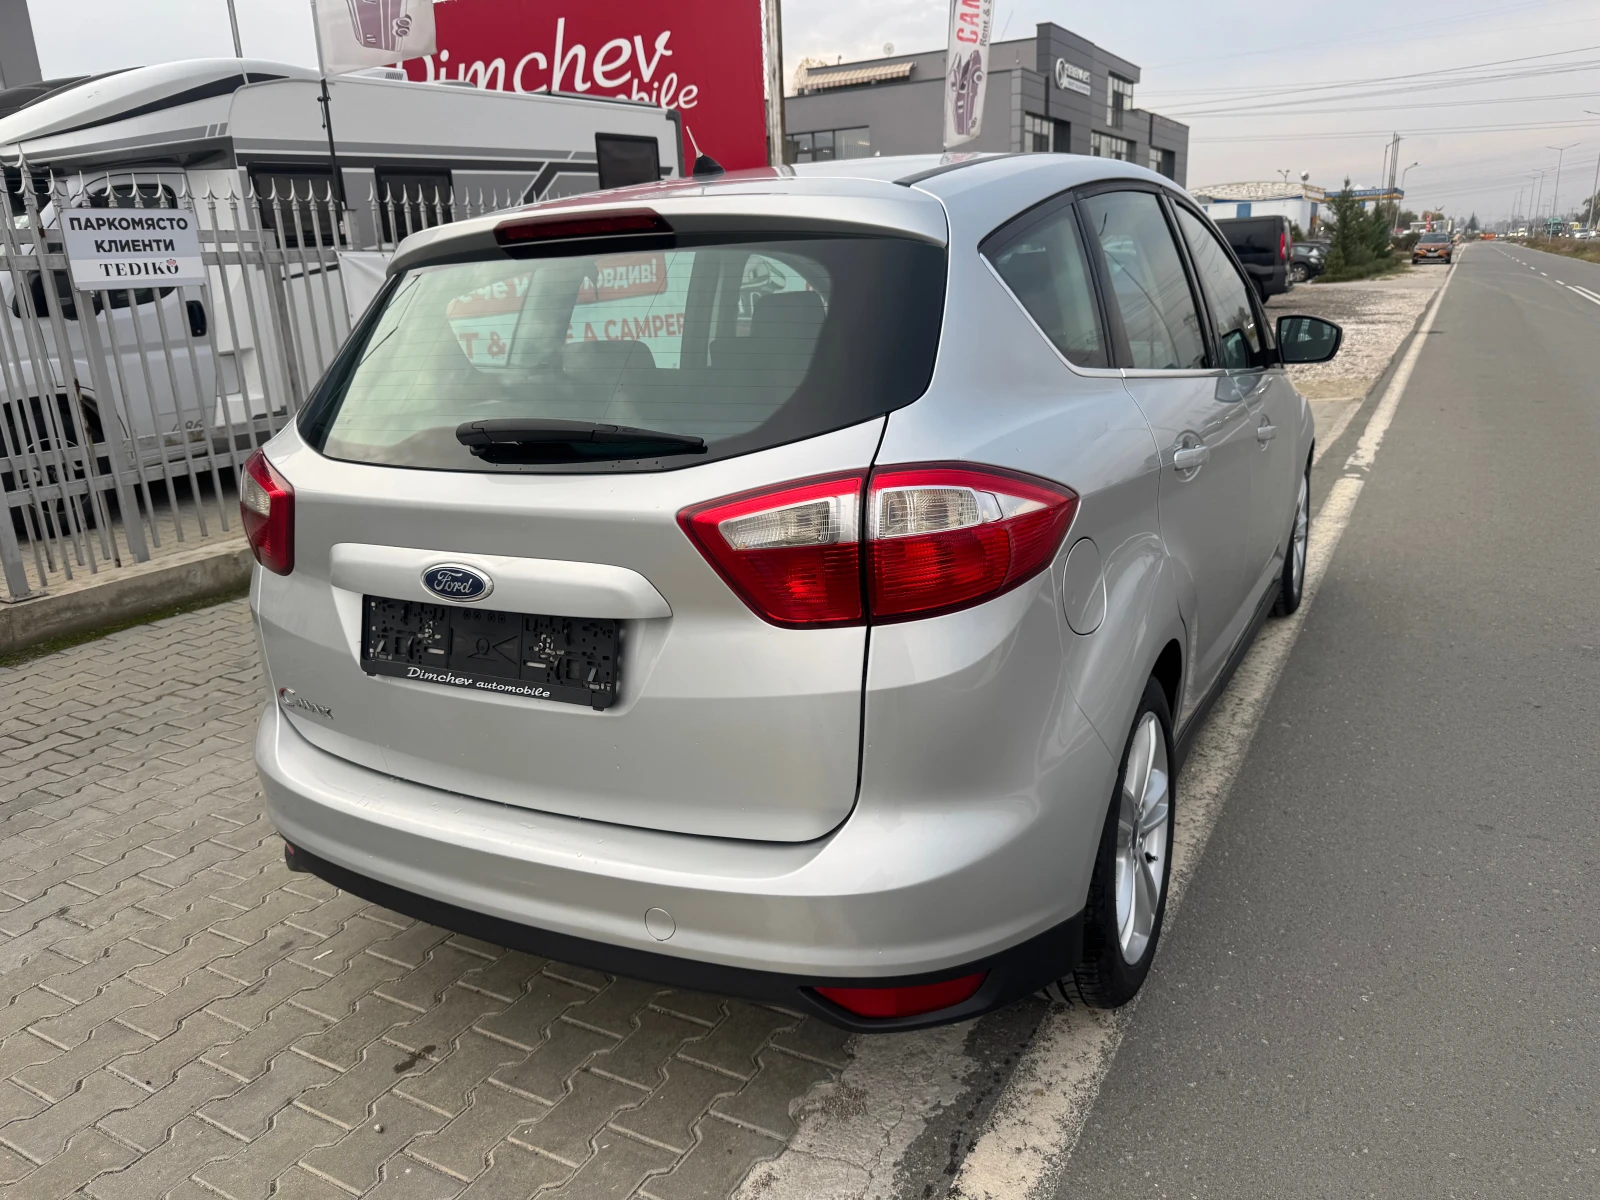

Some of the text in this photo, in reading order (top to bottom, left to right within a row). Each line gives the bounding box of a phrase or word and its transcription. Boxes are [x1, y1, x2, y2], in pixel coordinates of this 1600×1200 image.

[69, 217, 188, 231] ПАРКОМЯСТО
[95, 239, 175, 252] КЛИЕНТИ
[434, 570, 473, 593] Ford
[406, 666, 550, 698] Dimchev automobile
